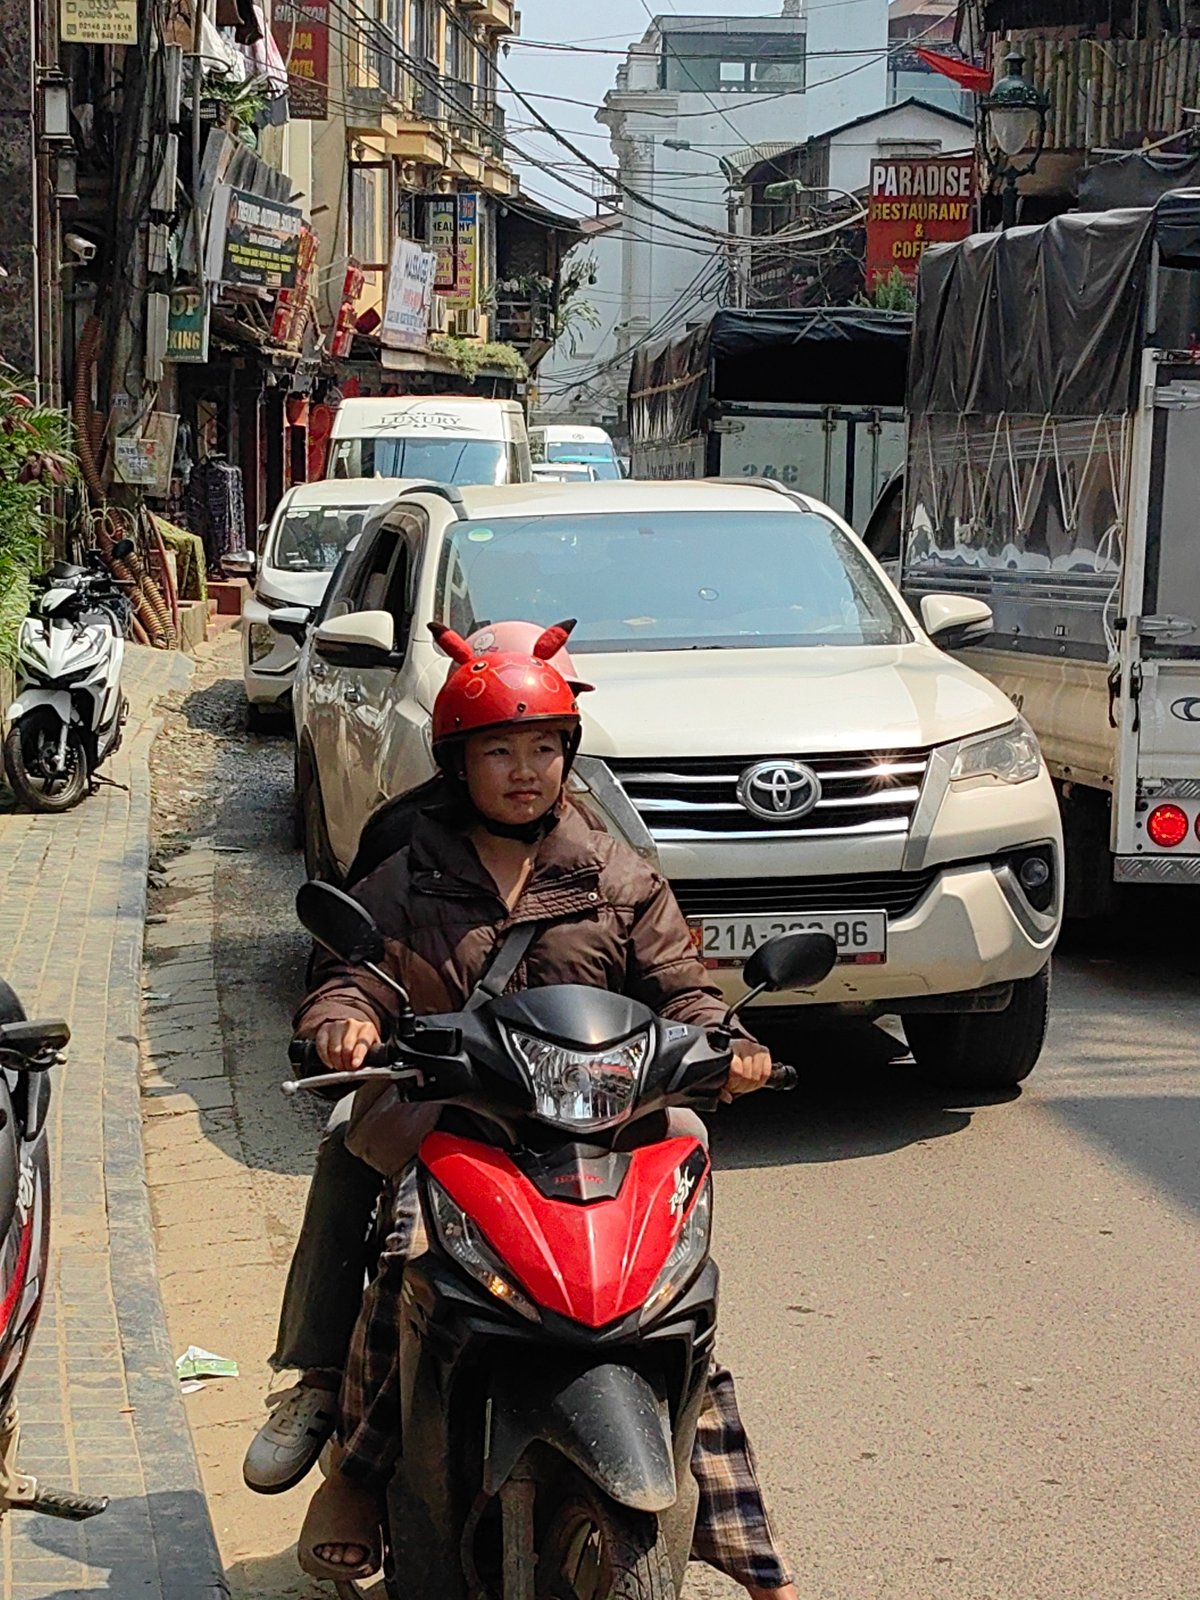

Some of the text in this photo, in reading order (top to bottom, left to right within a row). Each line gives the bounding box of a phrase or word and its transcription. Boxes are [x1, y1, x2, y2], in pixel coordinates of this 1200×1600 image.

[873, 165, 971, 197] PARADISE
[872, 202, 970, 220] RESTAURANT
[914, 223, 924, 237] &
[892, 241, 931, 258] COFF
[381, 415, 462, 426] LUXURY
[703, 920, 868, 951] 21A-86
